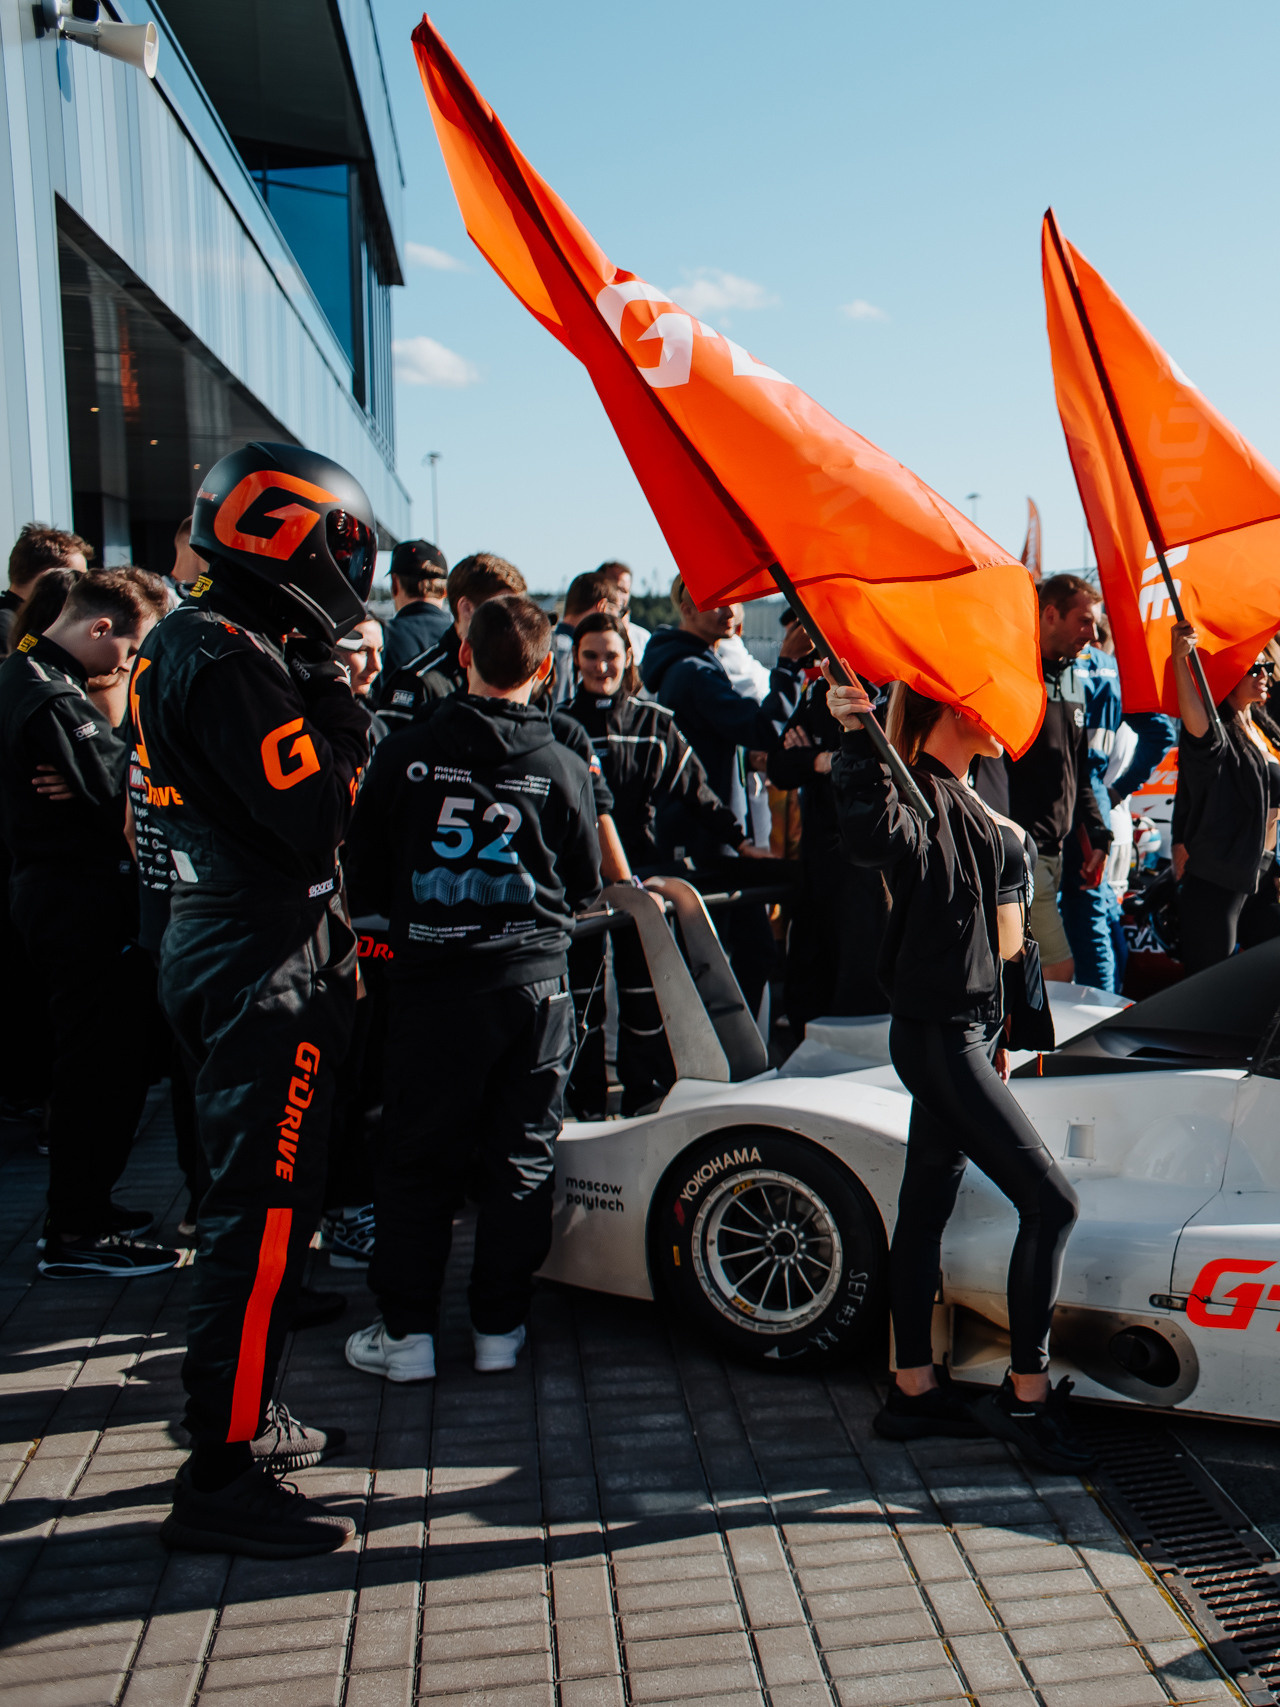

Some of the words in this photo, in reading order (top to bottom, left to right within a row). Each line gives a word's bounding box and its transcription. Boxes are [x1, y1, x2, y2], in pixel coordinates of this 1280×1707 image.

[261, 717, 320, 790] G
[431, 796, 522, 865] 52
[565, 1176, 623, 1196] moscow
[680, 1147, 762, 1202] YOKOHAMA
[566, 1192, 624, 1213] polytech
[847, 1268, 869, 1305] SET
